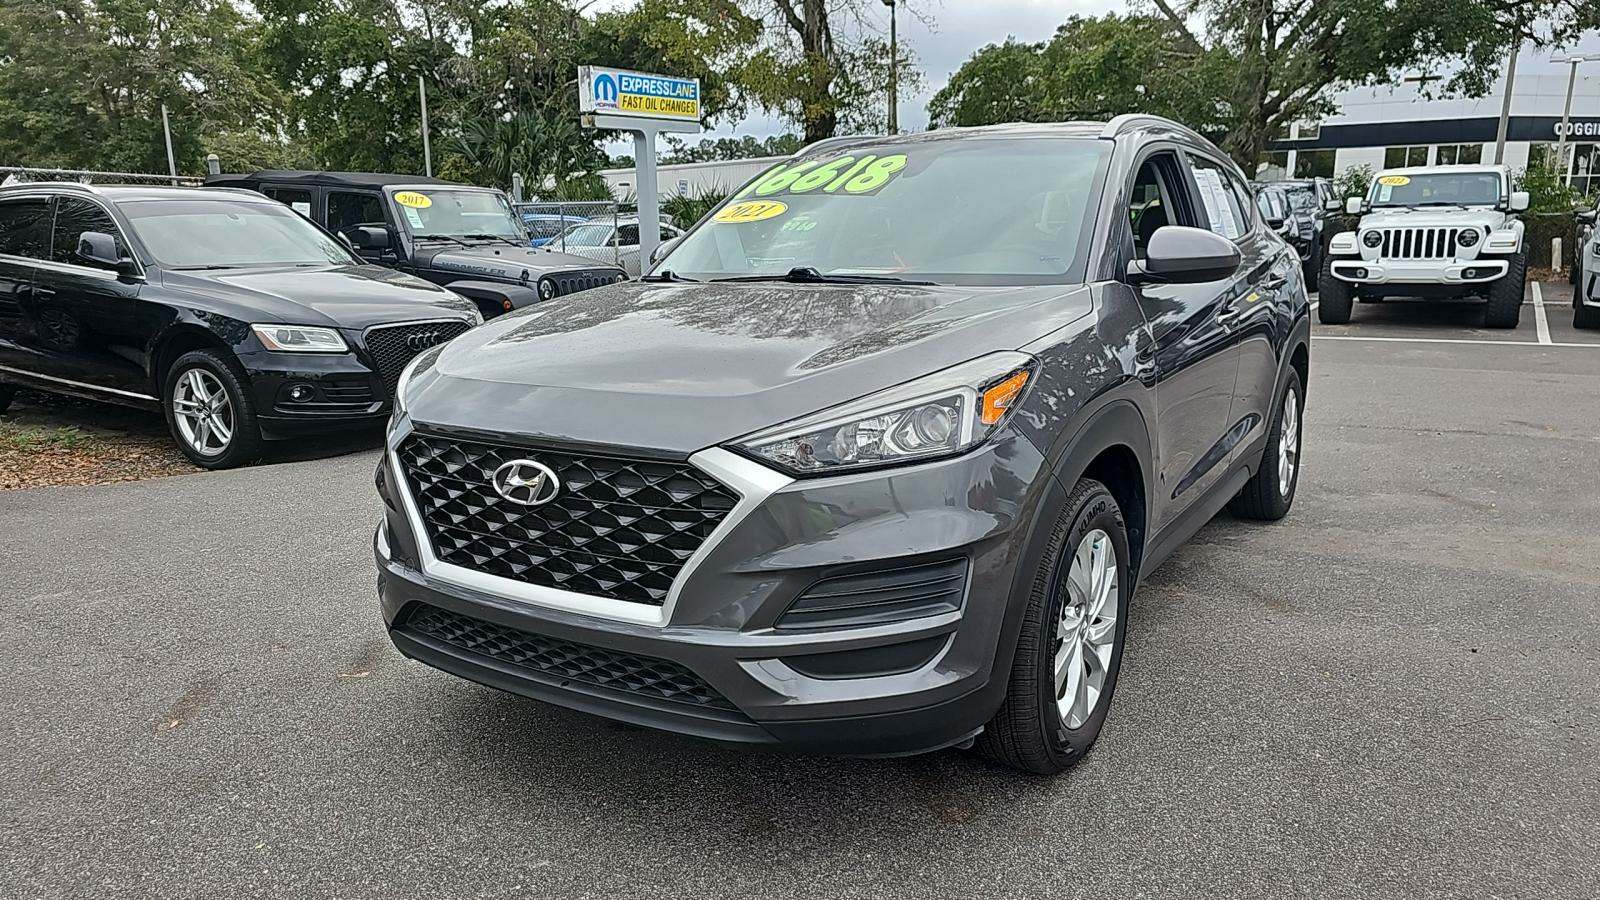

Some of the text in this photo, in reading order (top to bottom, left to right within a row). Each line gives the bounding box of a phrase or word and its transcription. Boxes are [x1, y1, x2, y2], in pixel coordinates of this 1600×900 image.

[621, 95, 696, 114] FAST OIL CHANGES
[1554, 122, 1600, 136] COGGI
[734, 154, 908, 200] 16618
[402, 194, 425, 205] 2017
[442, 261, 507, 277] WRANGLER
[1079, 500, 1106, 535] KUMHO
